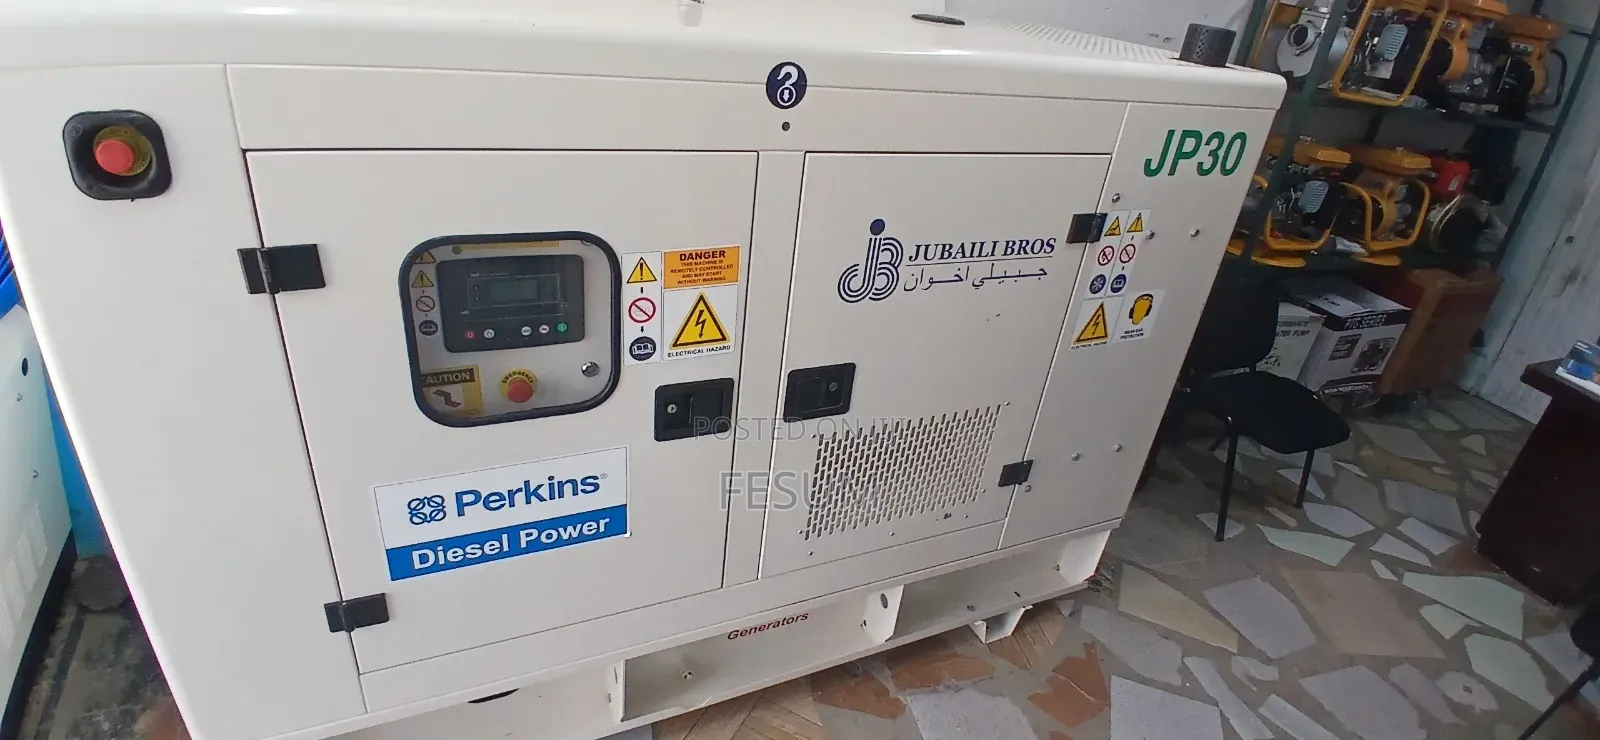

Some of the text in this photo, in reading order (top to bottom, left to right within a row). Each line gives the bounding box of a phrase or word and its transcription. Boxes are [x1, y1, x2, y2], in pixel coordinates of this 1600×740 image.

[1144, 129, 1247, 177] JP30
[680, 250, 726, 261] DANGER
[908, 237, 1057, 262] JUBAILI BROS
[668, 349, 705, 357] ELECTRICAL
[411, 517, 610, 570] Diesel Power
[727, 612, 809, 640] Generators
